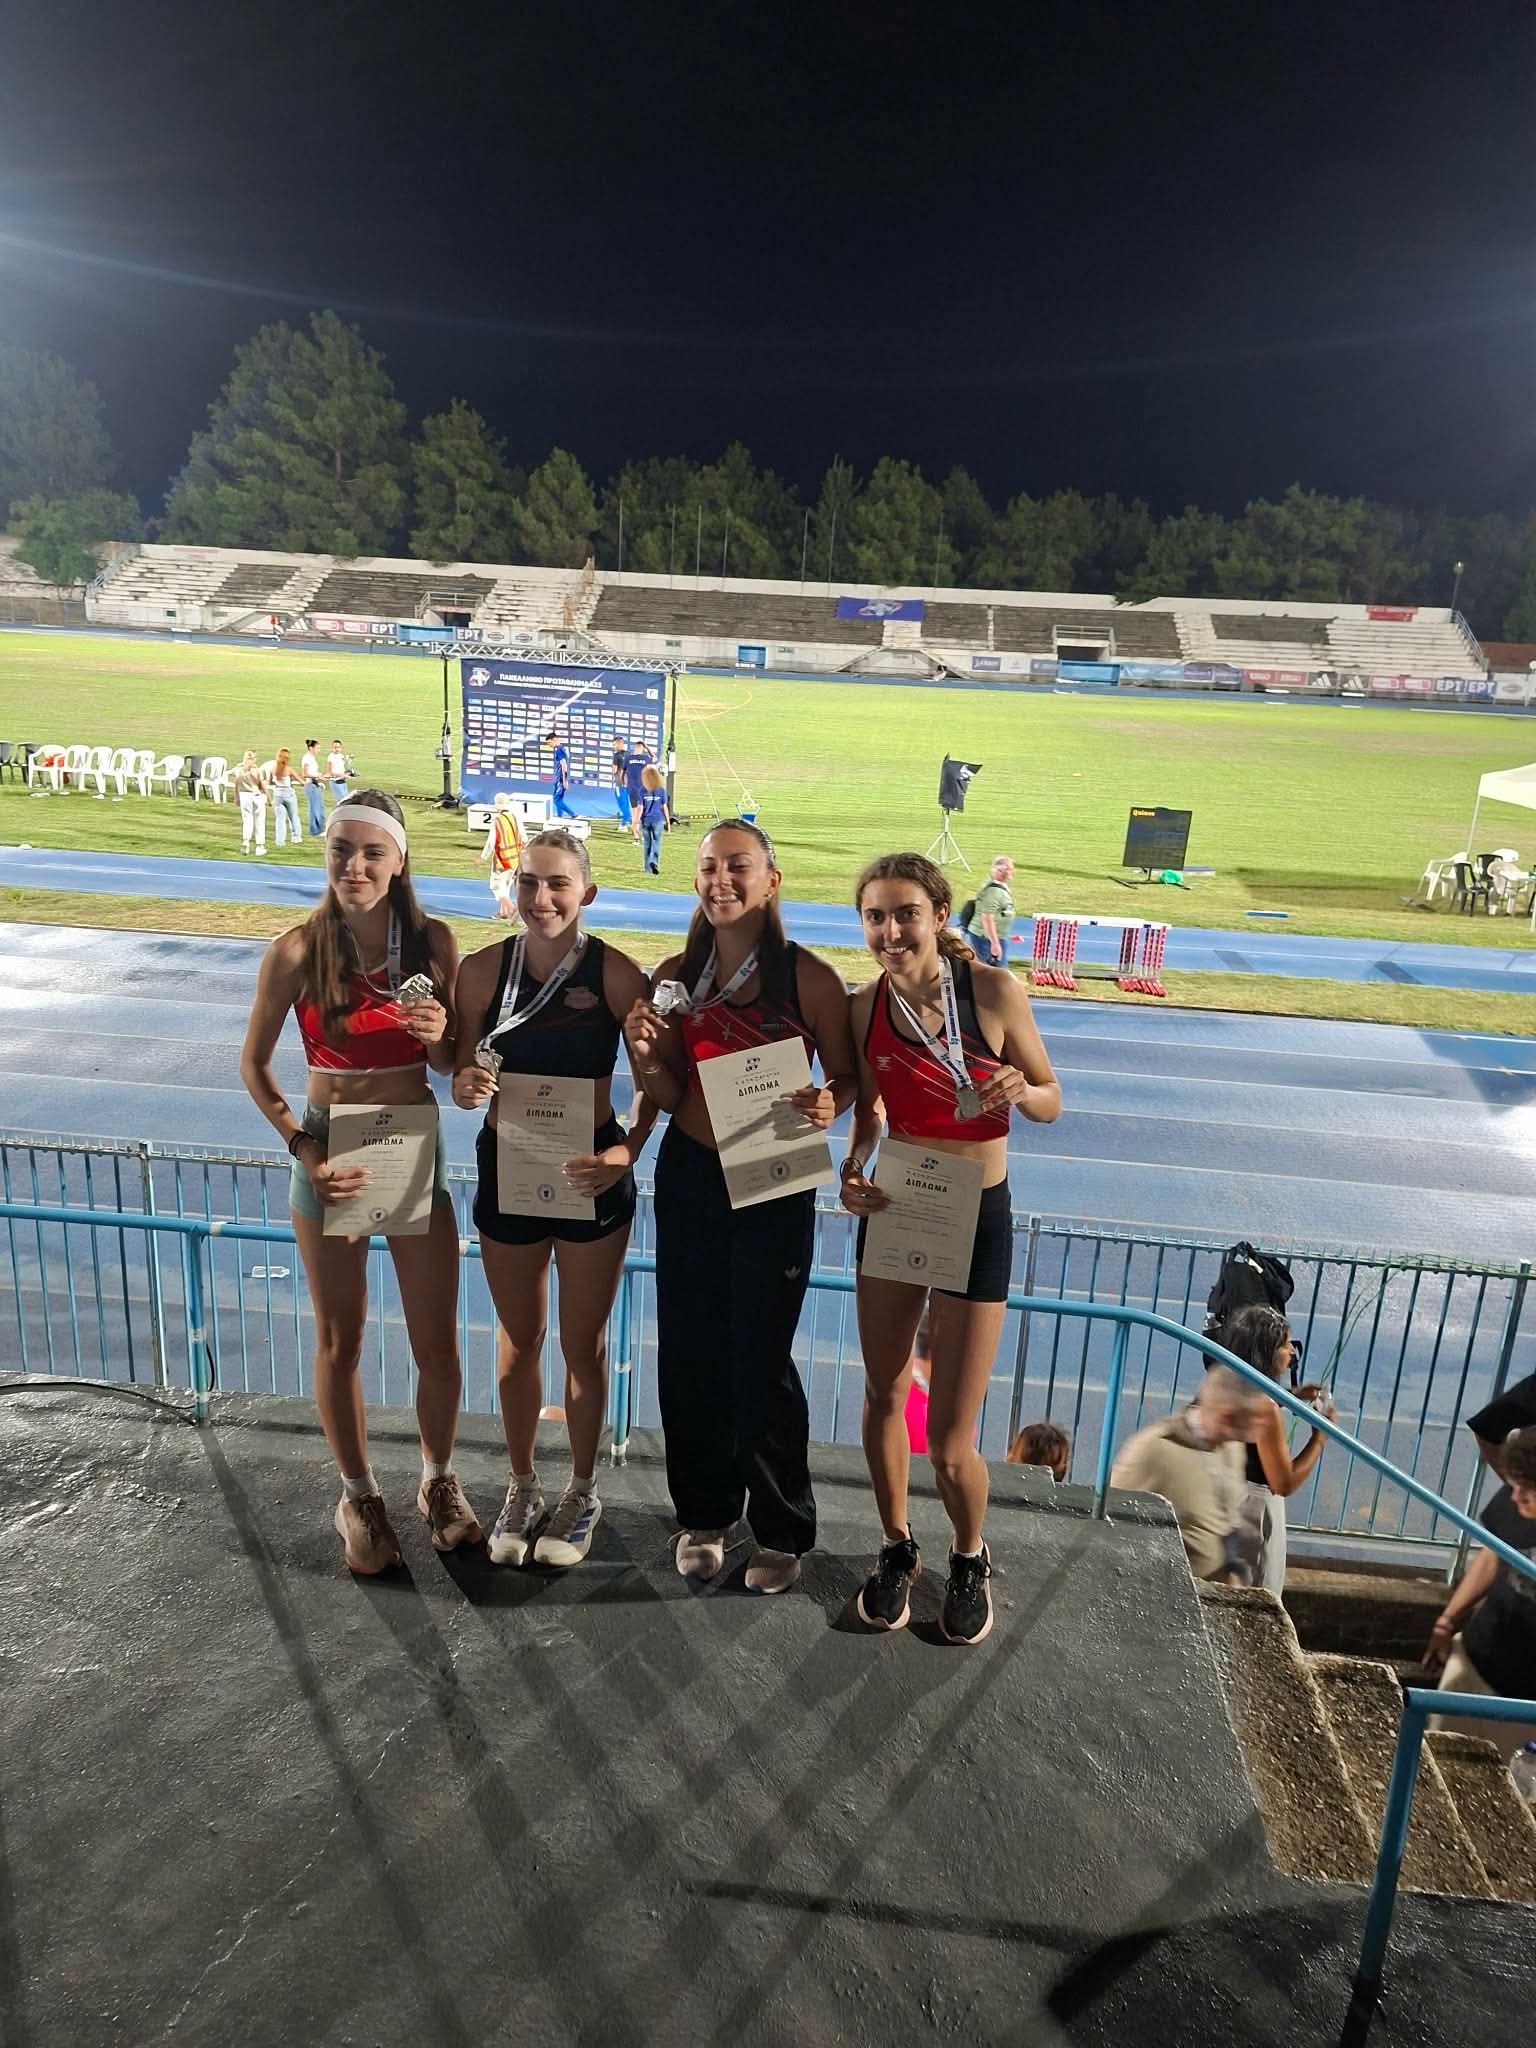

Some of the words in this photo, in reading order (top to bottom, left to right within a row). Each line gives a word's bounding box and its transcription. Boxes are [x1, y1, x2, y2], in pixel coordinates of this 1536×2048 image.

[371, 623, 395, 635] ΕΡΤ
[456, 629, 480, 641] ΕΡΤ
[1436, 680, 1463, 692] ΕΡΤ
[1468, 681, 1496, 695] ΕΡΤ
[522, 802, 528, 814] 1
[483, 812, 492, 824] 2
[738, 1079, 780, 1097] ΔΙΠΛΩΜΑ
[526, 1109, 564, 1119] ΔΙΠΛΩΜΑ
[362, 1138, 404, 1147] ΔΙΠΛΩΜΑ
[905, 1178, 948, 1193] ΔΙΠΛΩΜΑ
